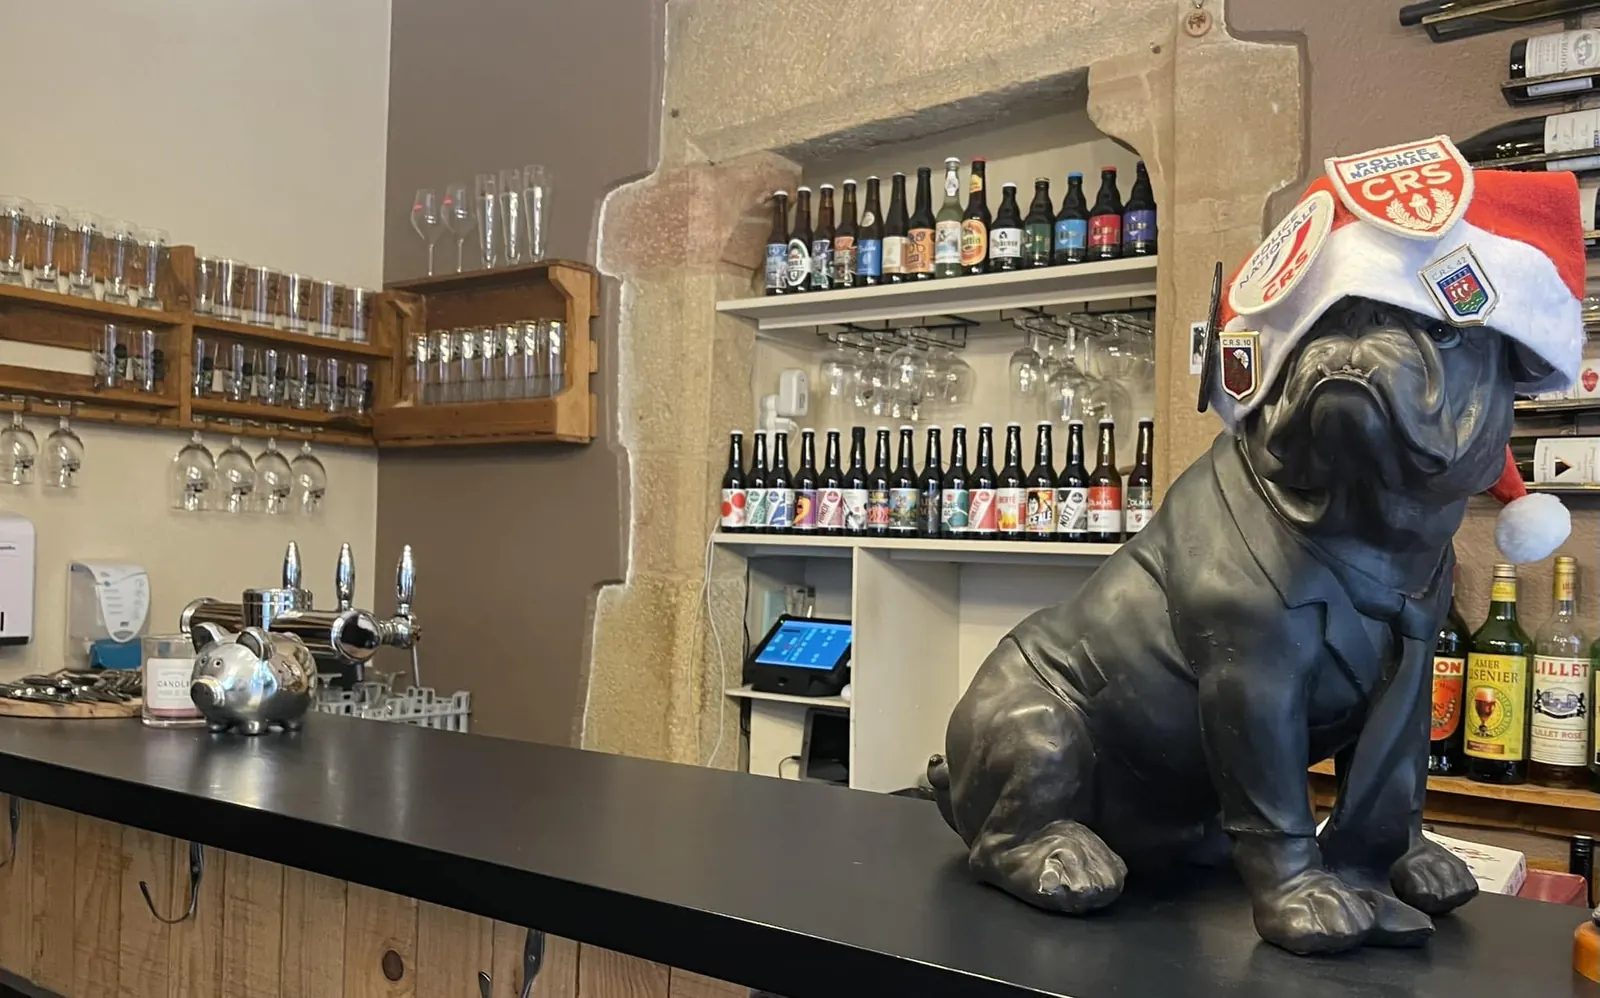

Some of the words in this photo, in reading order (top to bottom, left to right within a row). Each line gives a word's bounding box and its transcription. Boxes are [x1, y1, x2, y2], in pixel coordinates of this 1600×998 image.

[1350, 152, 1441, 179] NATIONALE
[1355, 148, 1431, 170] POLICE
[1362, 164, 1452, 201] CRS
[1239, 202, 1317, 289] NATIONALE
[1252, 211, 1299, 266] POLICE
[1263, 249, 1308, 302] CRS
[1474, 658, 1500, 669] AMER
[1534, 661, 1589, 677] LILLET
